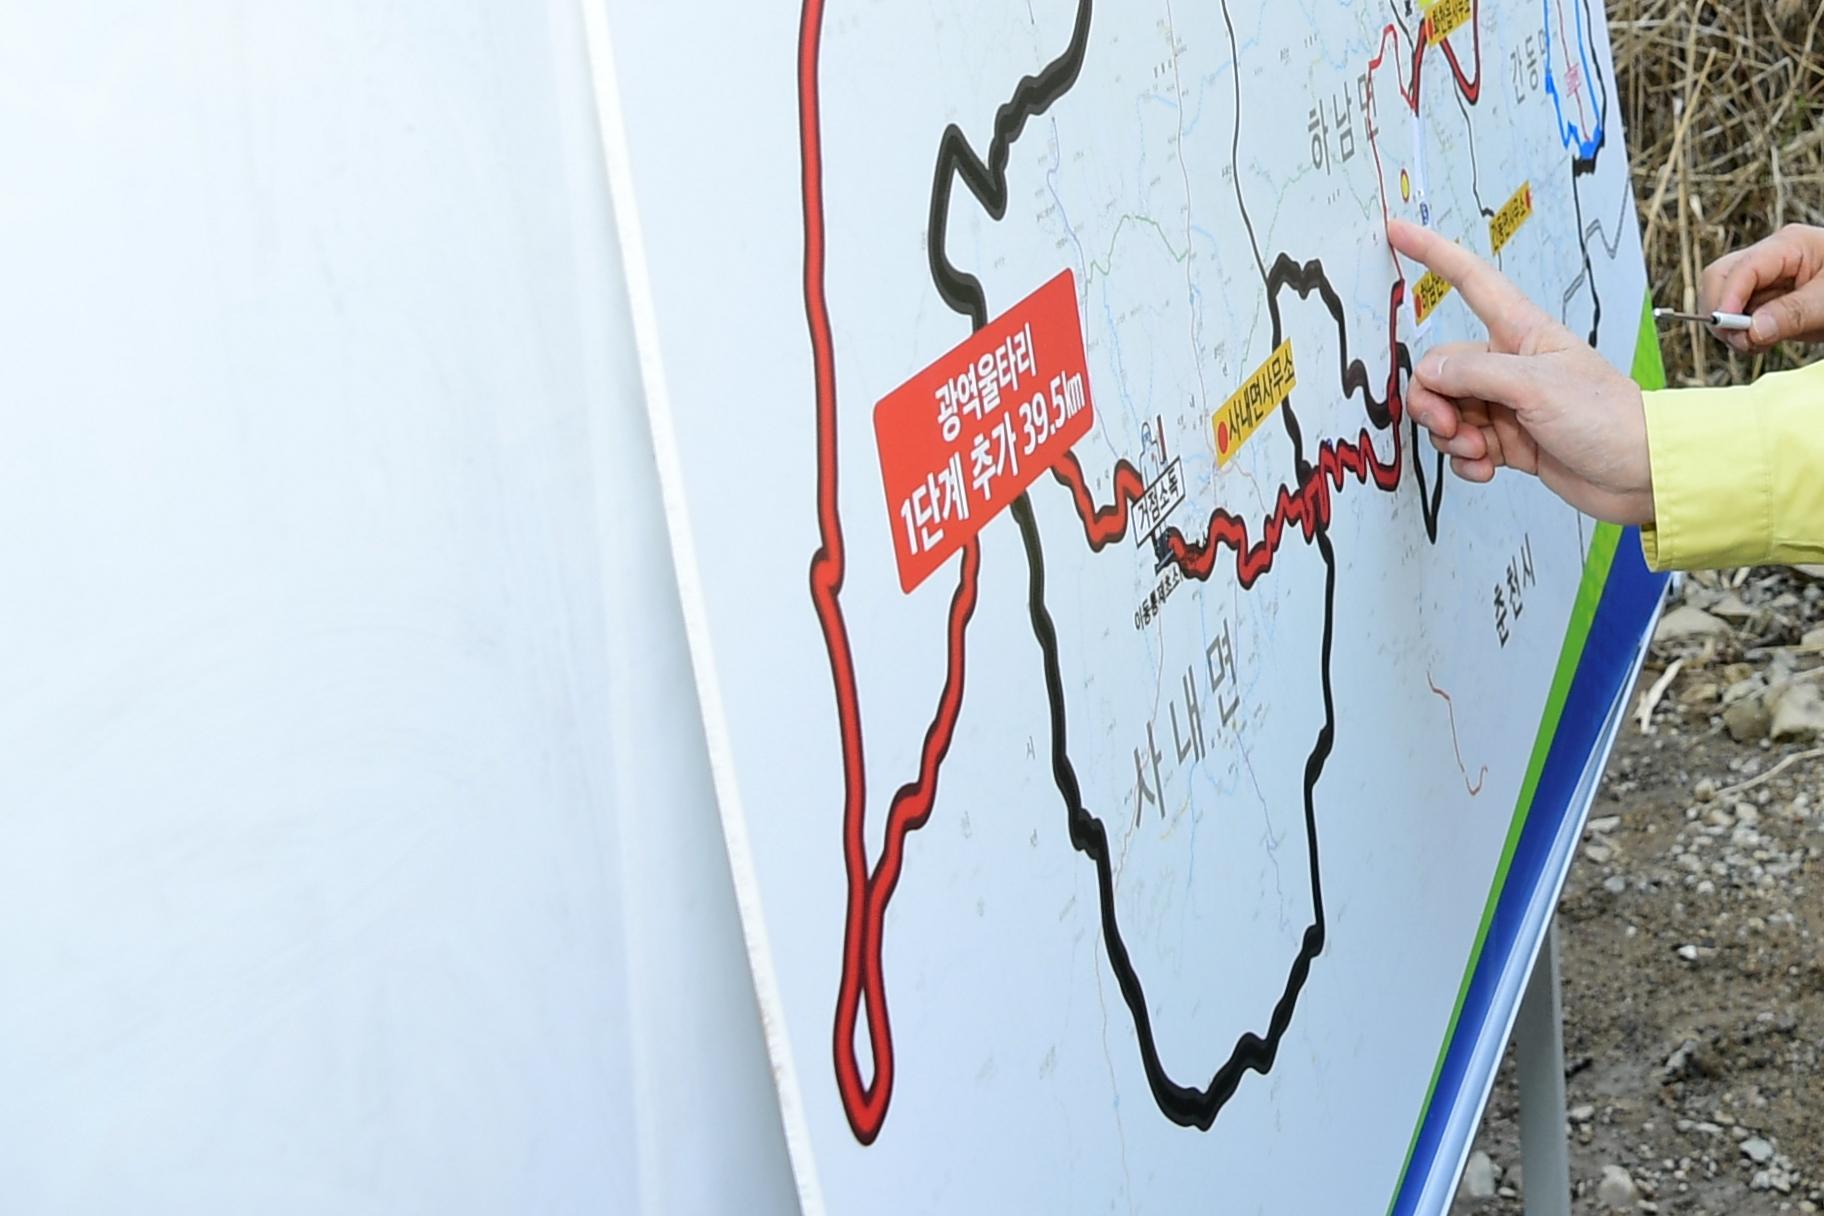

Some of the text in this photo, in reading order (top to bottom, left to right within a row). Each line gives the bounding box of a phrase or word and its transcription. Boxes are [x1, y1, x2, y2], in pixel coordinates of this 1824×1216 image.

[1308, 73, 1379, 176] 하남면
[935, 322, 1036, 442] 광역울타리
[1229, 349, 1294, 441] 사내면사무소
[901, 371, 1086, 556] 1단계 추가 39.5km
[1138, 467, 1179, 532] 거점소독
[1494, 533, 1536, 648] 춘천시
[1132, 618, 1240, 828] 사내면
